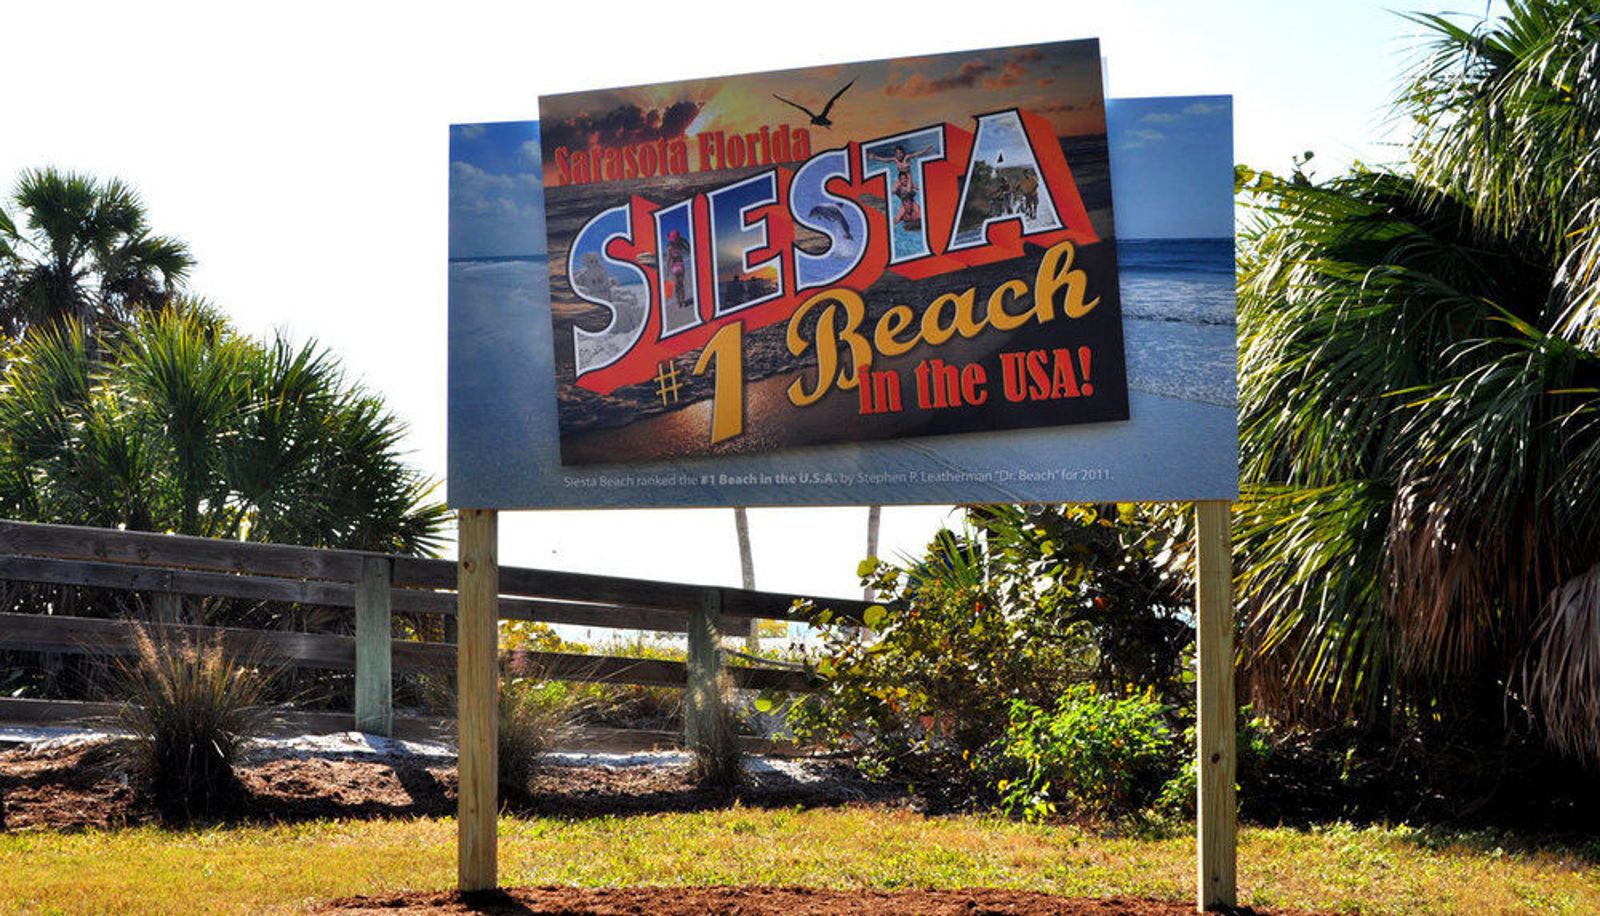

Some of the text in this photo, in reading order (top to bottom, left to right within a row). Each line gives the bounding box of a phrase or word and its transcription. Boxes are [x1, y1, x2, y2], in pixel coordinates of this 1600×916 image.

[554, 123, 812, 186] Sarasota Florida
[567, 107, 1066, 380] SIESTA
[786, 240, 1101, 407] Beach
[858, 345, 1094, 415] in the USA!
[563, 468, 1115, 489] Siesta Beach ranked the #1 Beach in the U.S.A. by Stephen P. Leatherman "Dr. Beach" for 2011.
